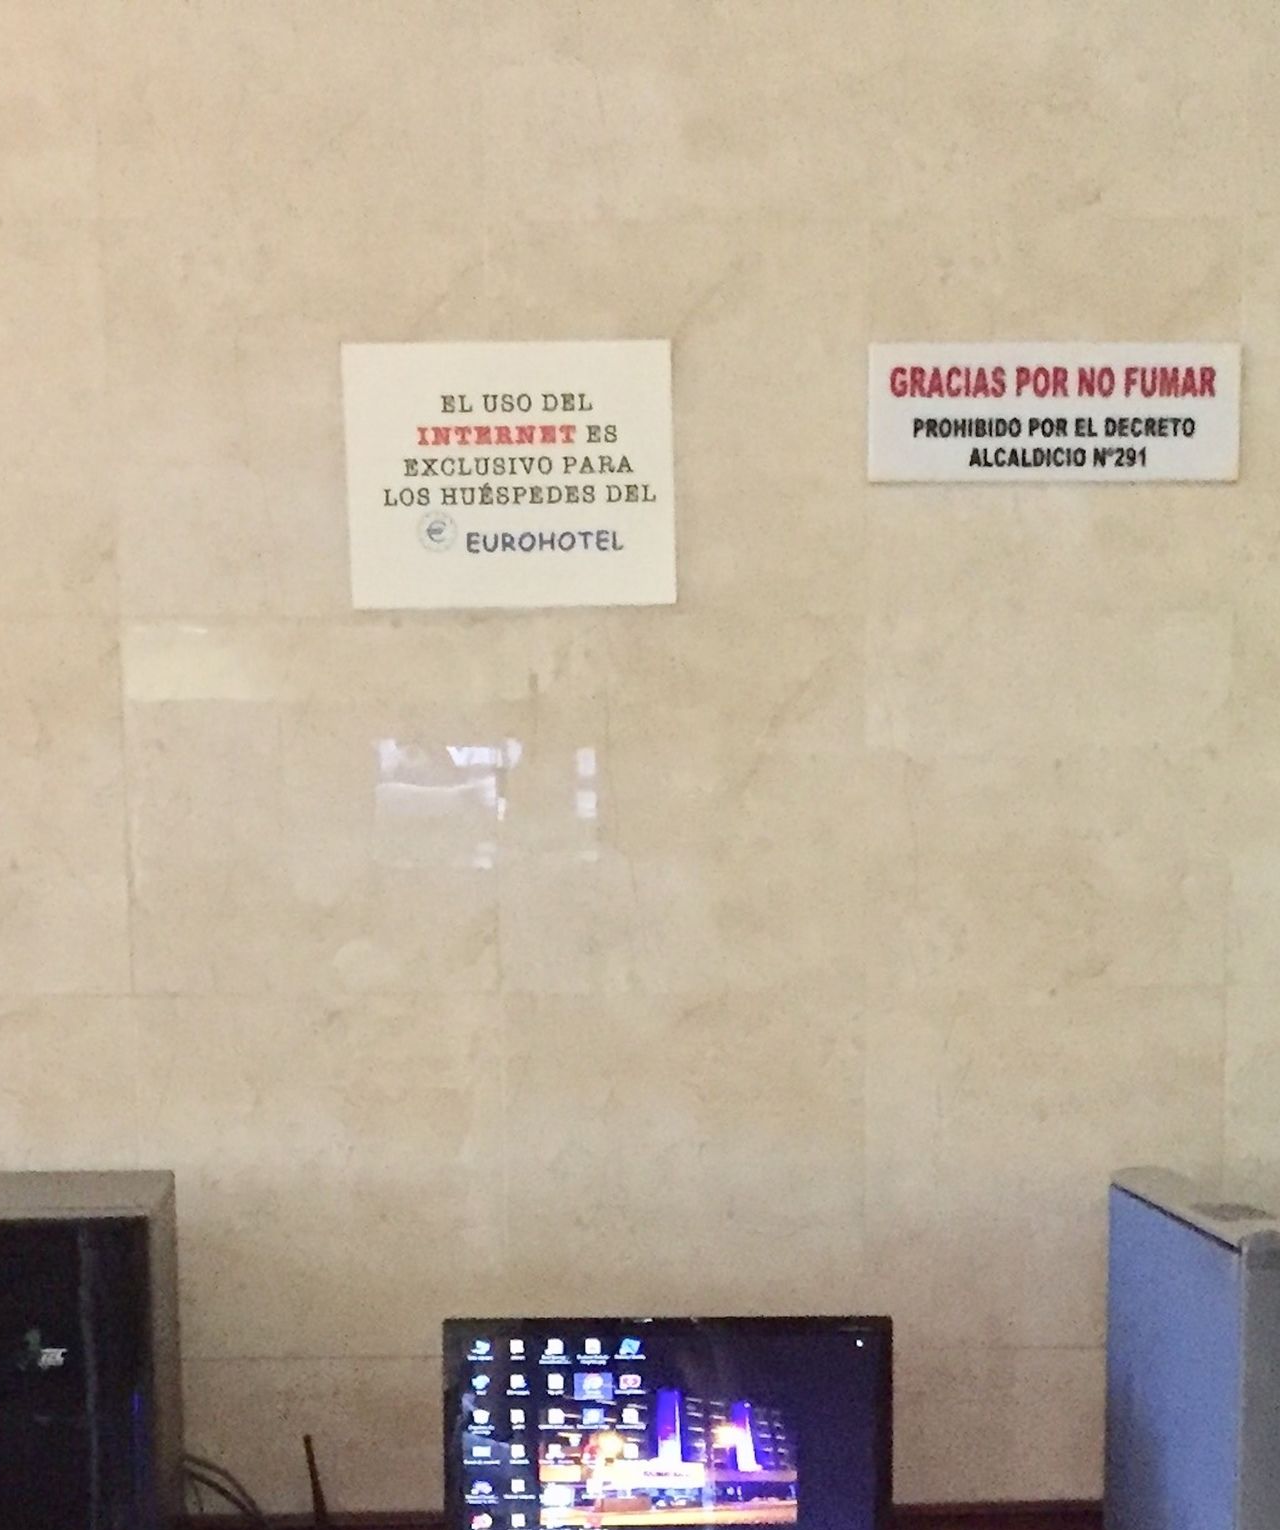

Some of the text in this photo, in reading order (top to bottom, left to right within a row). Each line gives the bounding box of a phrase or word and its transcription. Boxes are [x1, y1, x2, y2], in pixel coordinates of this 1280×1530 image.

[889, 365, 1217, 399] GRACIAS POR NO FUMAR
[440, 392, 594, 414] EL USO DEL
[416, 424, 618, 446] INTERNET ES
[913, 416, 1196, 439] PROHIBIDO POR EL DECRETO
[403, 454, 634, 477] EXCLUSIVO PARA
[968, 446, 1087, 468] ALCALDICIO
[383, 481, 657, 507] LOS HUÉSPEDES DEL
[466, 529, 625, 555] EUROHOTEL
